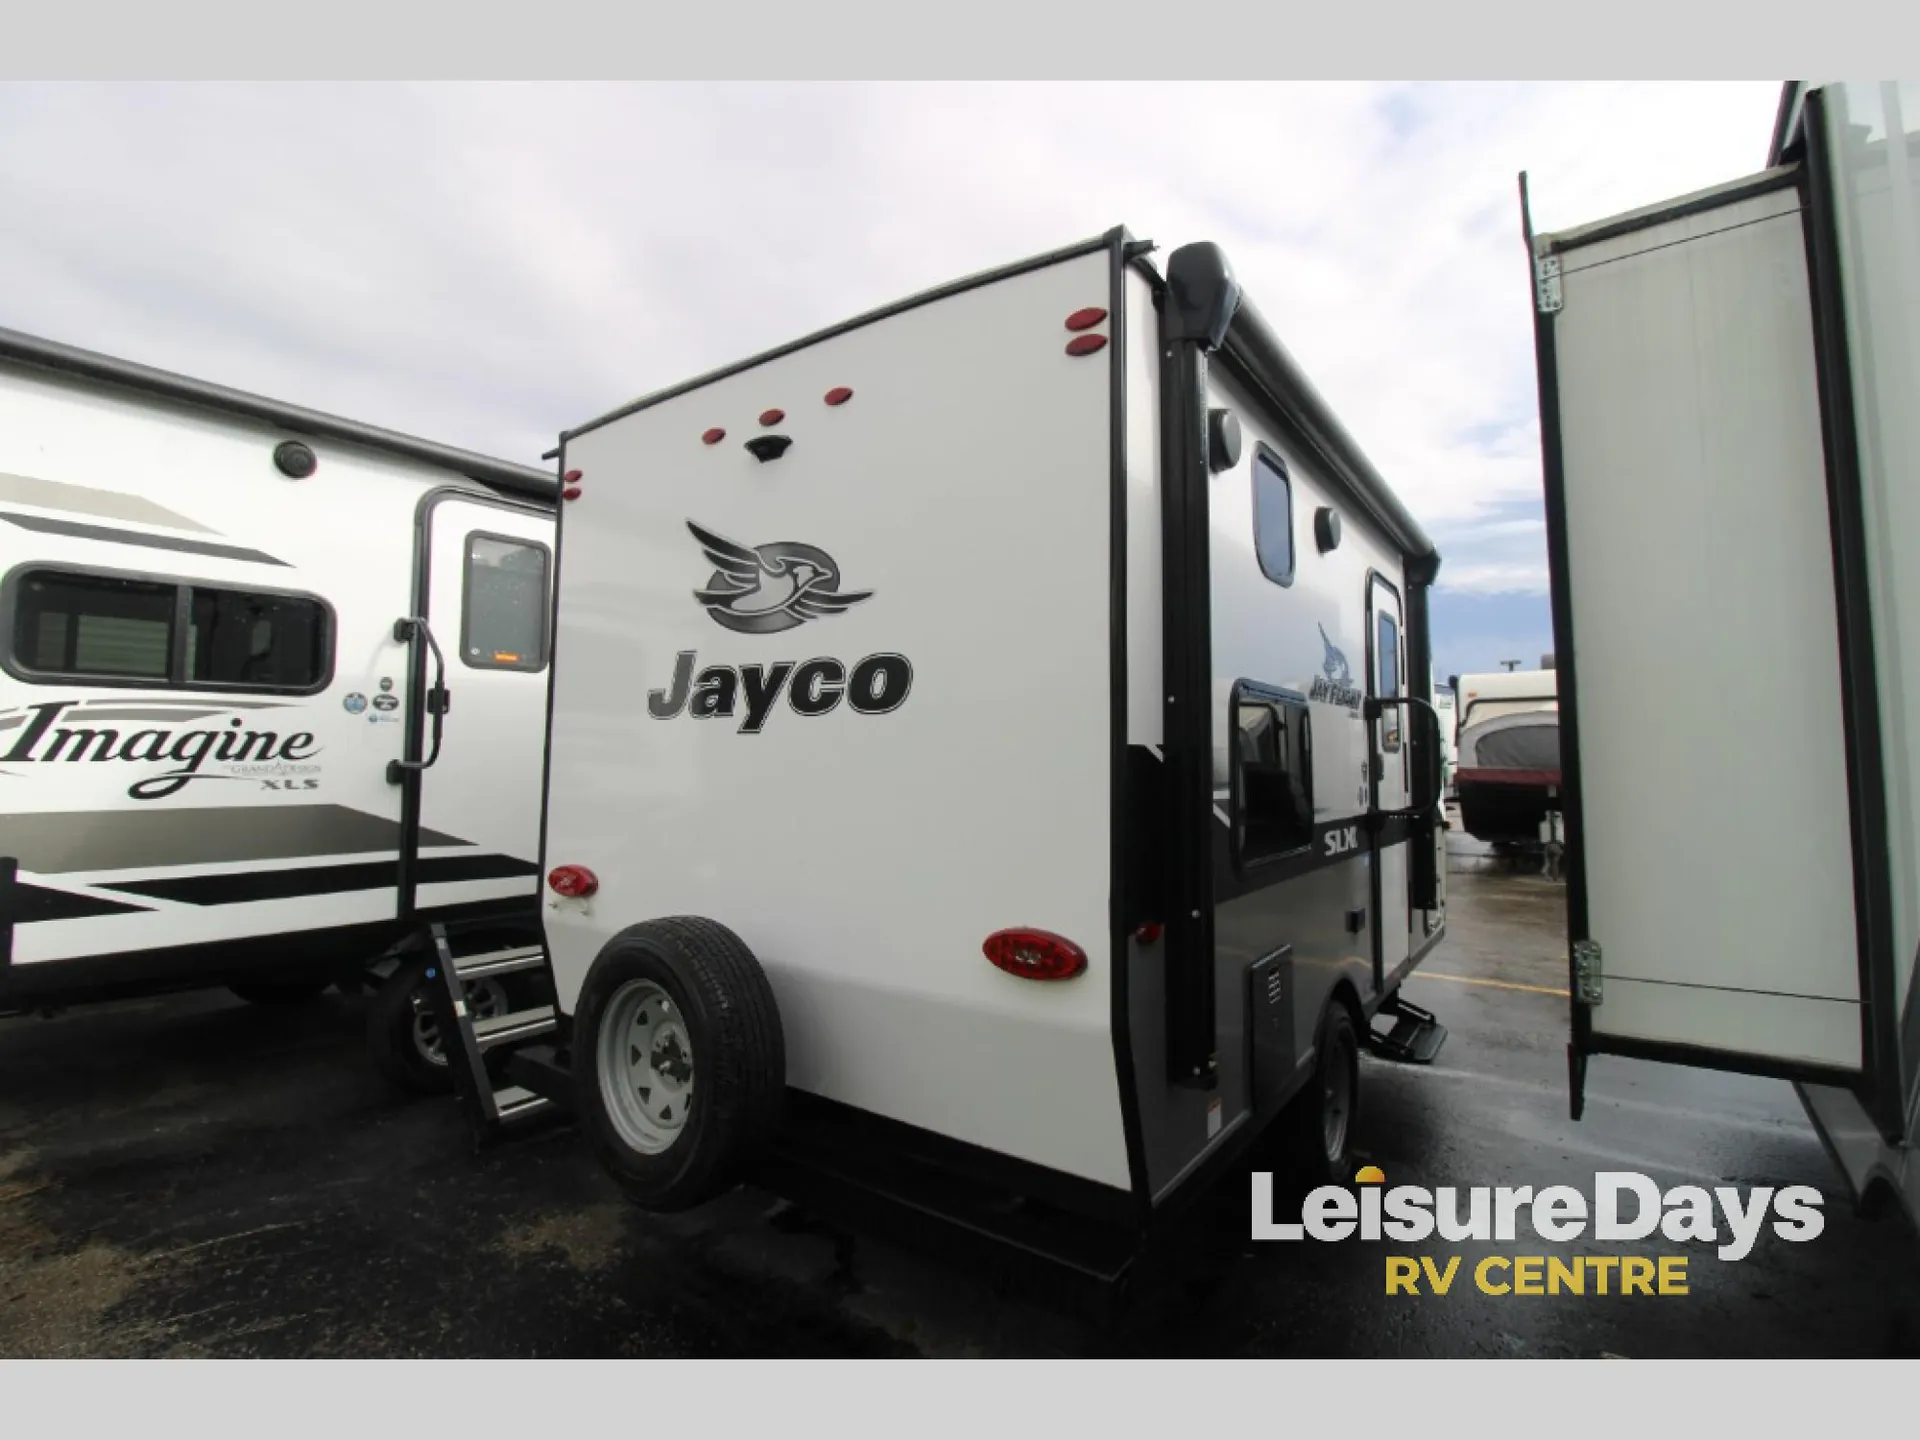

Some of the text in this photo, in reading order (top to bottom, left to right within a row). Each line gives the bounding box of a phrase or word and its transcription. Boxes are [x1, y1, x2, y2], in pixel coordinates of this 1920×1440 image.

[647, 649, 914, 734] Jayco
[0, 700, 323, 800] Imagine
[260, 778, 320, 791] XLS
[1323, 826, 1358, 857] SLX
